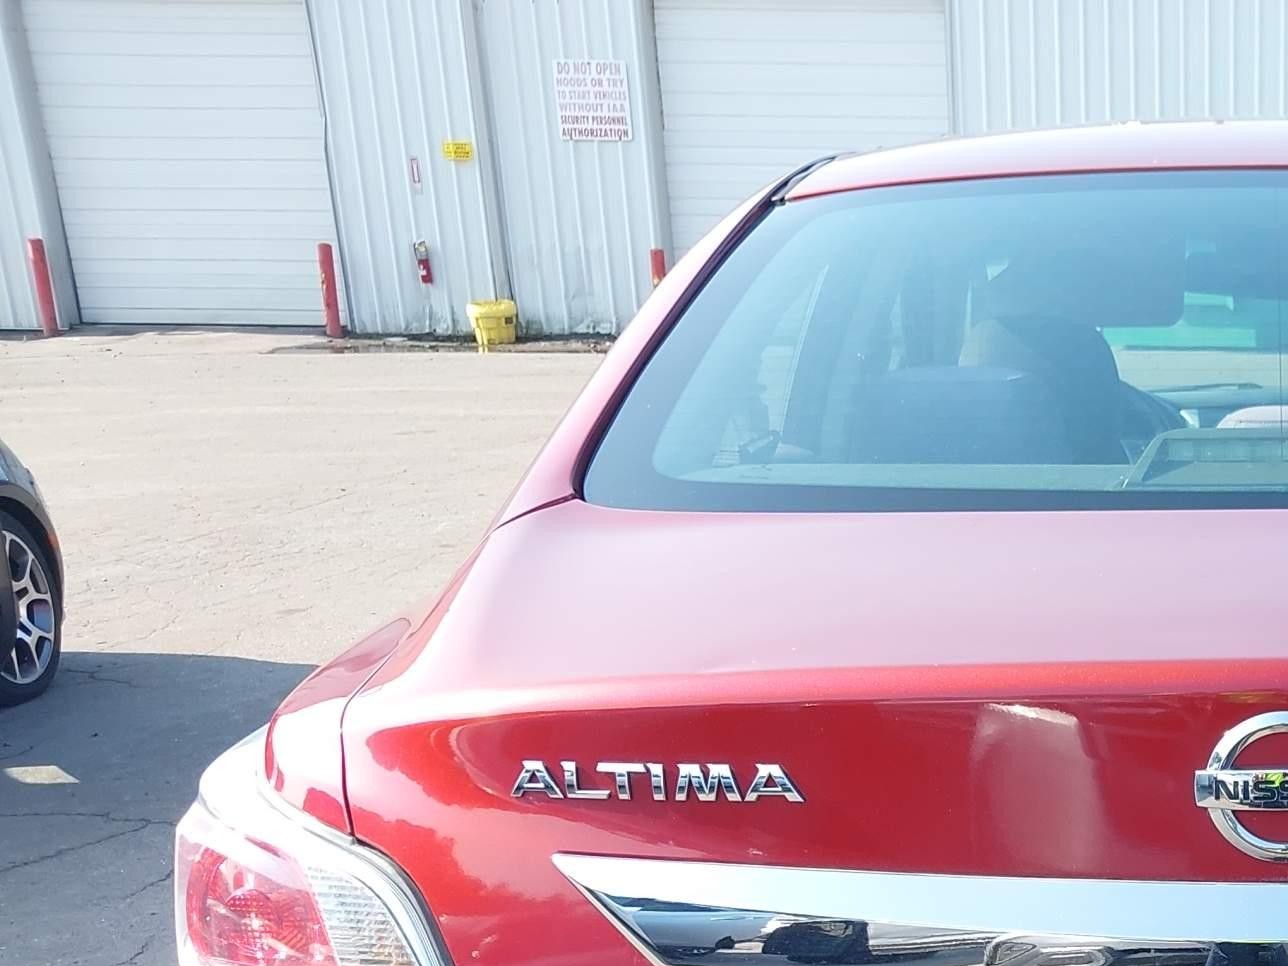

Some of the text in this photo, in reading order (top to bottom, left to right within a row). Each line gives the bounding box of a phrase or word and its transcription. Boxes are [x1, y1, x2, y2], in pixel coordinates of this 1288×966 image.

[557, 61, 621, 76] DO NOT OPEN
[556, 78, 625, 88] HOODS OR TRY
[558, 90, 627, 101] TO START VEHICLES
[559, 102, 604, 113] WITHOUT
[560, 115, 628, 126] SECURITY PERSONNEL
[561, 127, 630, 139] AUTHORIZATION
[510, 760, 805, 803] ALTIMA
